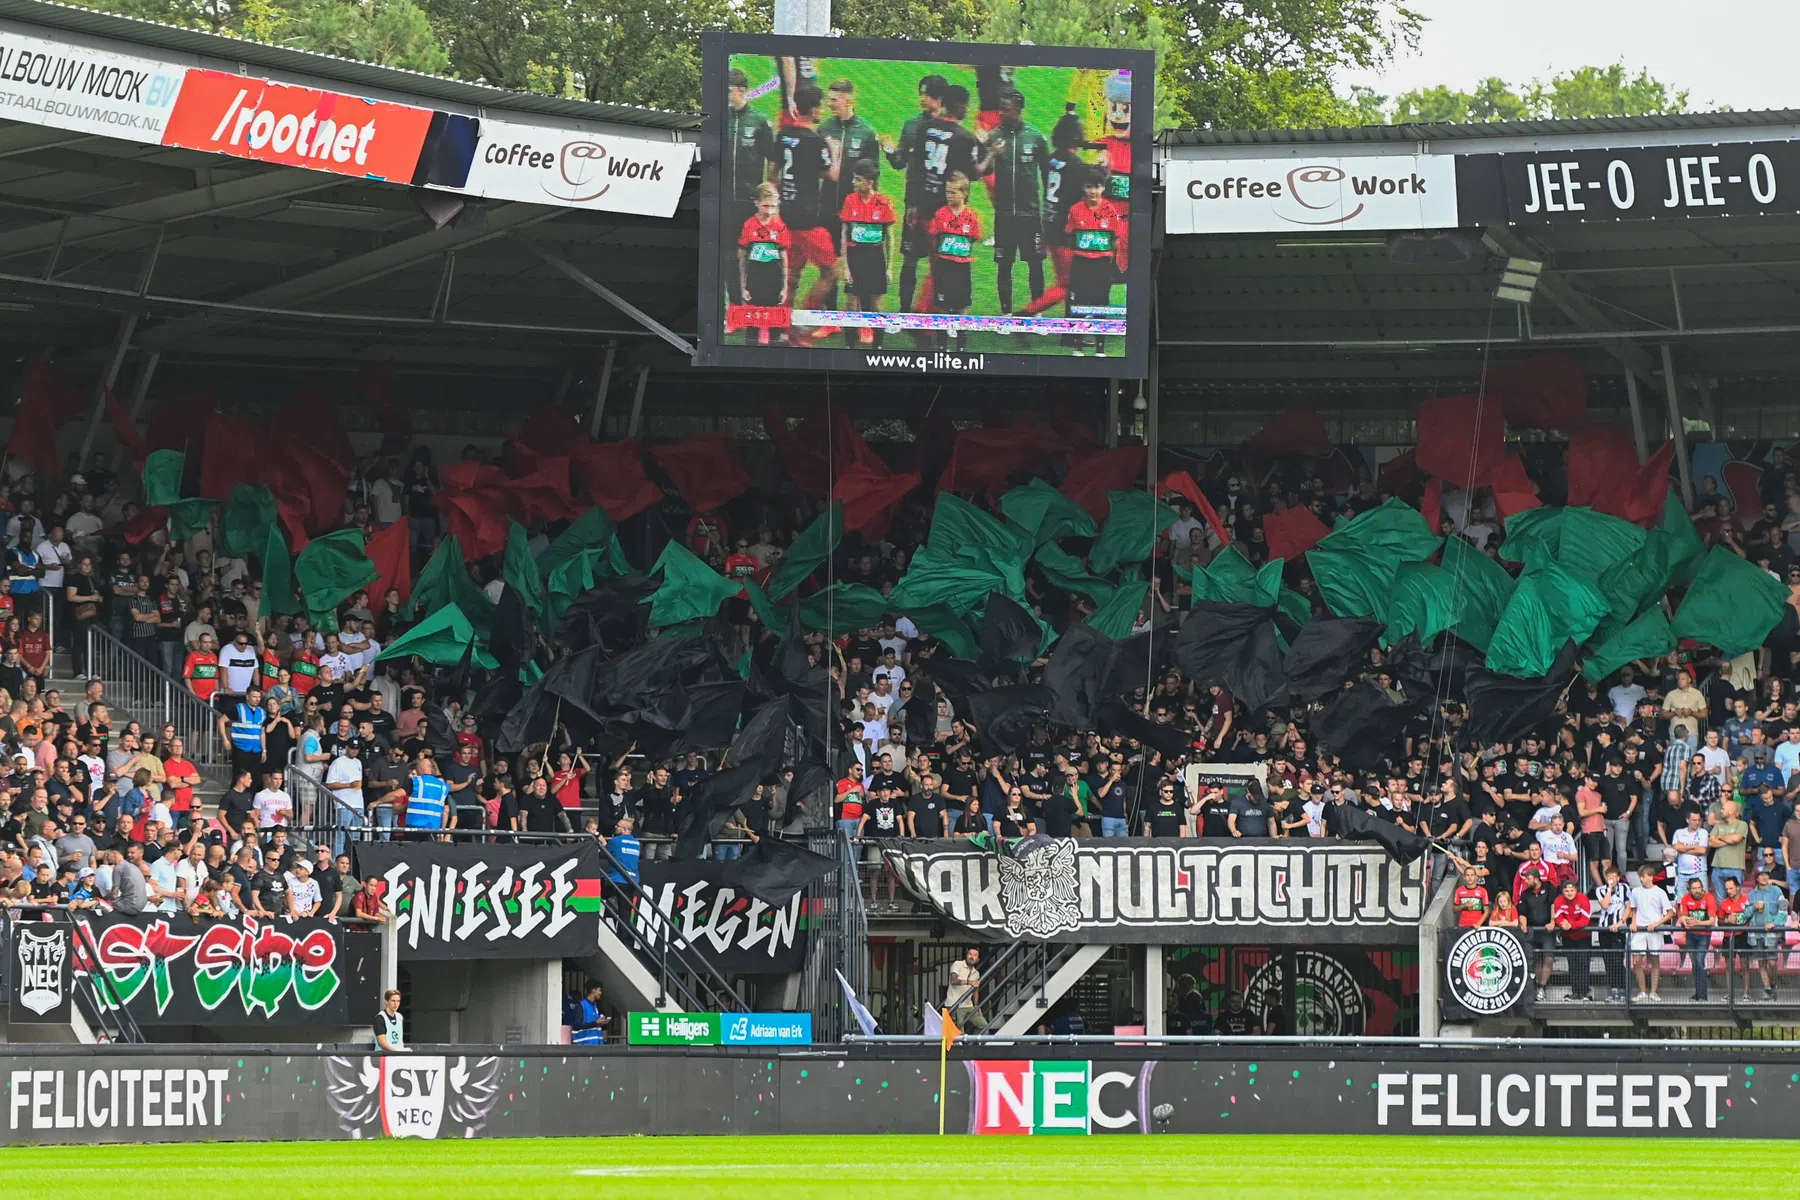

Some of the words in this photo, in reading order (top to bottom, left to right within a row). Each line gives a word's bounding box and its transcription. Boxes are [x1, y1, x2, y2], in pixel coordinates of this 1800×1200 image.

[81, 63, 149, 103] MOOK
[145, 74, 181, 108] BV
[484, 143, 555, 169] Coffee
[607, 156, 664, 182] Work
[1186, 177, 1282, 200] Coffee
[1351, 172, 1427, 196] Work
[865, 352, 985, 373] www.q-lite.nl
[1451, 930, 1488, 968] NIJMEGEN
[1489, 930, 1523, 968] FANATICS
[25, 964, 59, 988] NEC
[1463, 991, 1489, 1010] SINCE
[1489, 991, 1511, 1010] 2014
[750, 1024, 778, 1038] Adriaan
[778, 1027, 791, 1038] van
[791, 1025, 803, 1038] Erk
[389, 1067, 440, 1099] SV
[9, 1069, 230, 1130] FELICITEERT
[983, 1070, 1138, 1129] NEC
[1376, 1073, 1729, 1129] FELICITEERT
[395, 1107, 433, 1128] NEC
